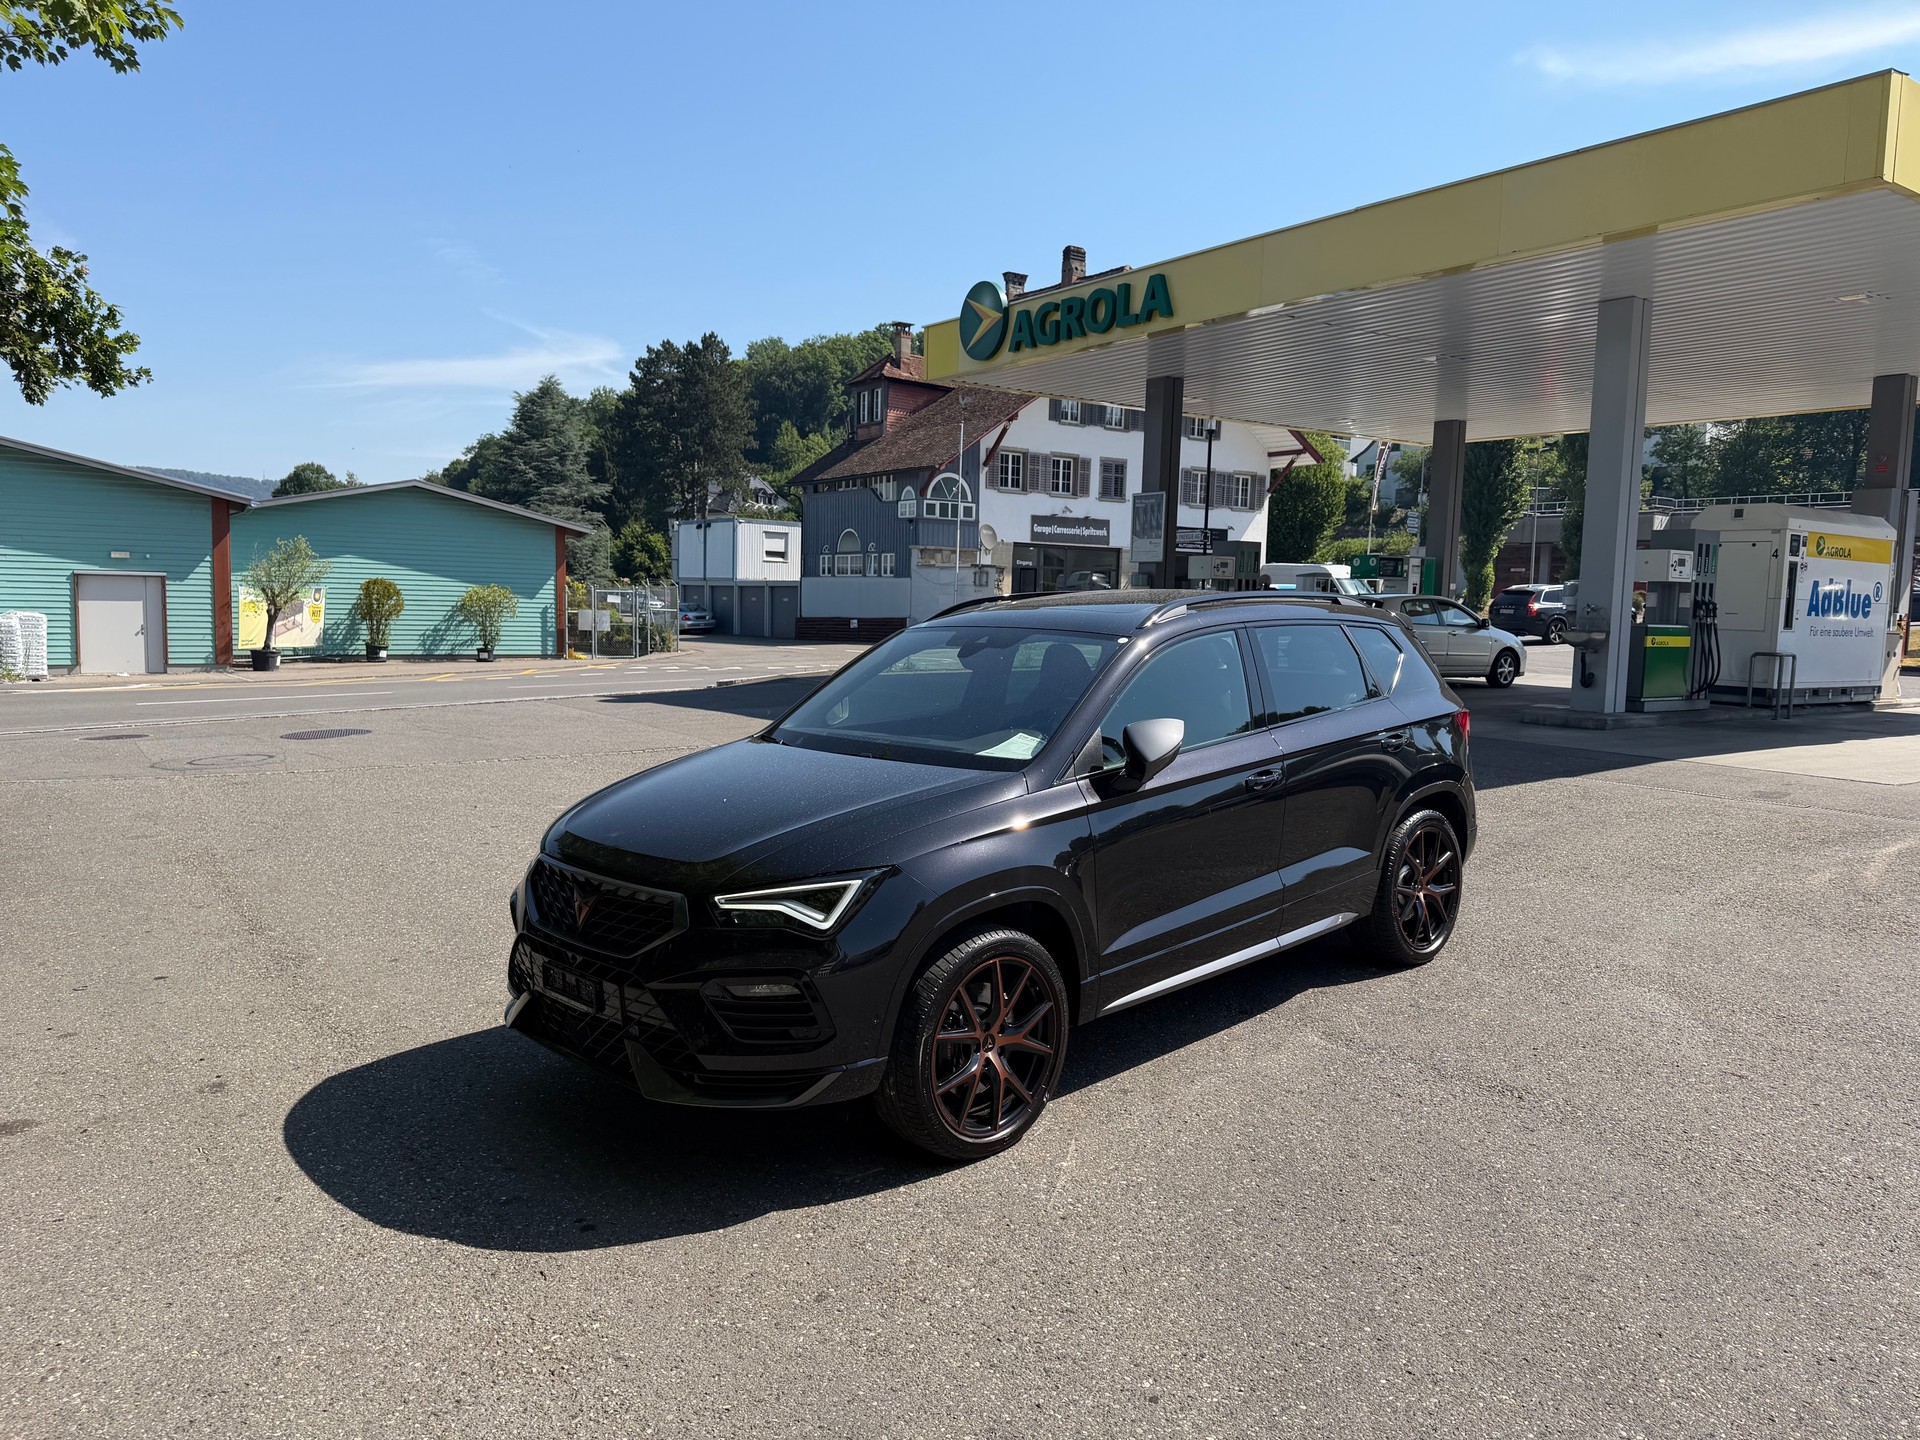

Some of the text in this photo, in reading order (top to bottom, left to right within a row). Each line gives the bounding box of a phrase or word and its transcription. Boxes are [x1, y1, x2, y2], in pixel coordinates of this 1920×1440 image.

[1008, 273, 1174, 353] AGROLA
[1771, 548, 1779, 559] 4
[1825, 546, 1852, 558] AGROLA
[1673, 560, 1678, 571] 2
[1809, 625, 1819, 637] Für
[1820, 626, 1831, 637] eine
[1832, 627, 1853, 638] saubere
